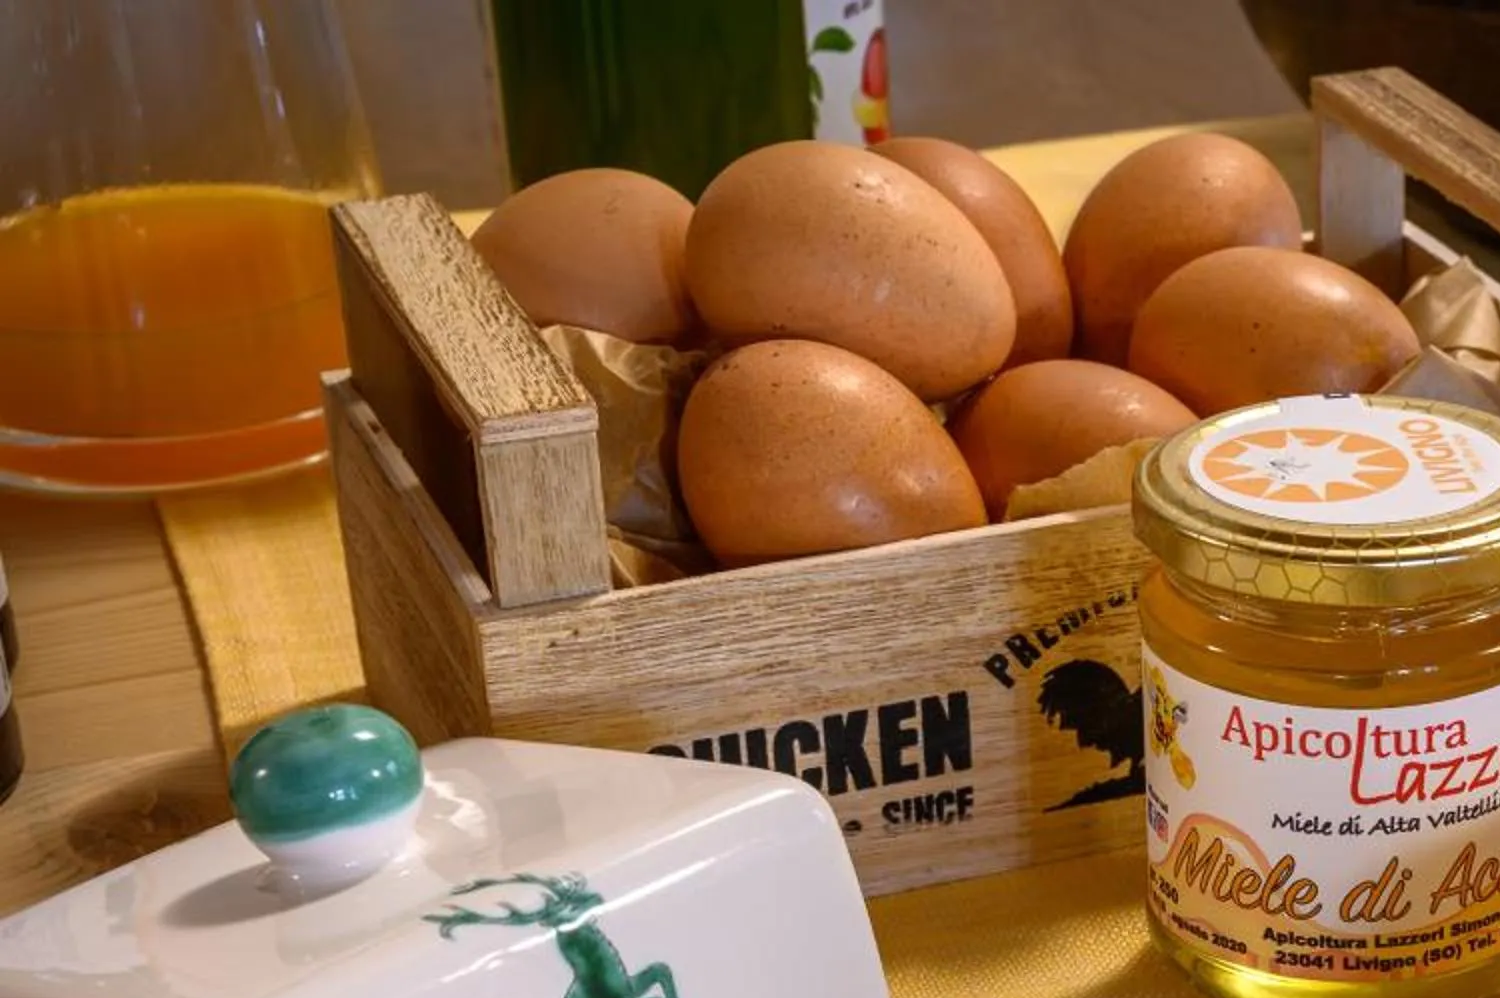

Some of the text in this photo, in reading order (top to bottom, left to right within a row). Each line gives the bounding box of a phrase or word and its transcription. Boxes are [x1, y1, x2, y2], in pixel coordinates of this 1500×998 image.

[1398, 418, 1478, 495] LIVIGNO
[650, 690, 973, 796] CKEN
[1221, 706, 1469, 762] Apicoltura
[882, 787, 974, 834] SINCE
[1271, 811, 1333, 837] Miele
[1338, 814, 1364, 836] di
[1368, 814, 1421, 836] Alta
[1173, 826, 1323, 922] Miele
[1338, 856, 1413, 923] di
[1263, 926, 1368, 950] Apicoltura
[1374, 926, 1446, 949] Lazzeri
[1274, 949, 1335, 971] 23041
[1343, 953, 1417, 974] Livigno
[1422, 942, 1463, 967] (SO)
